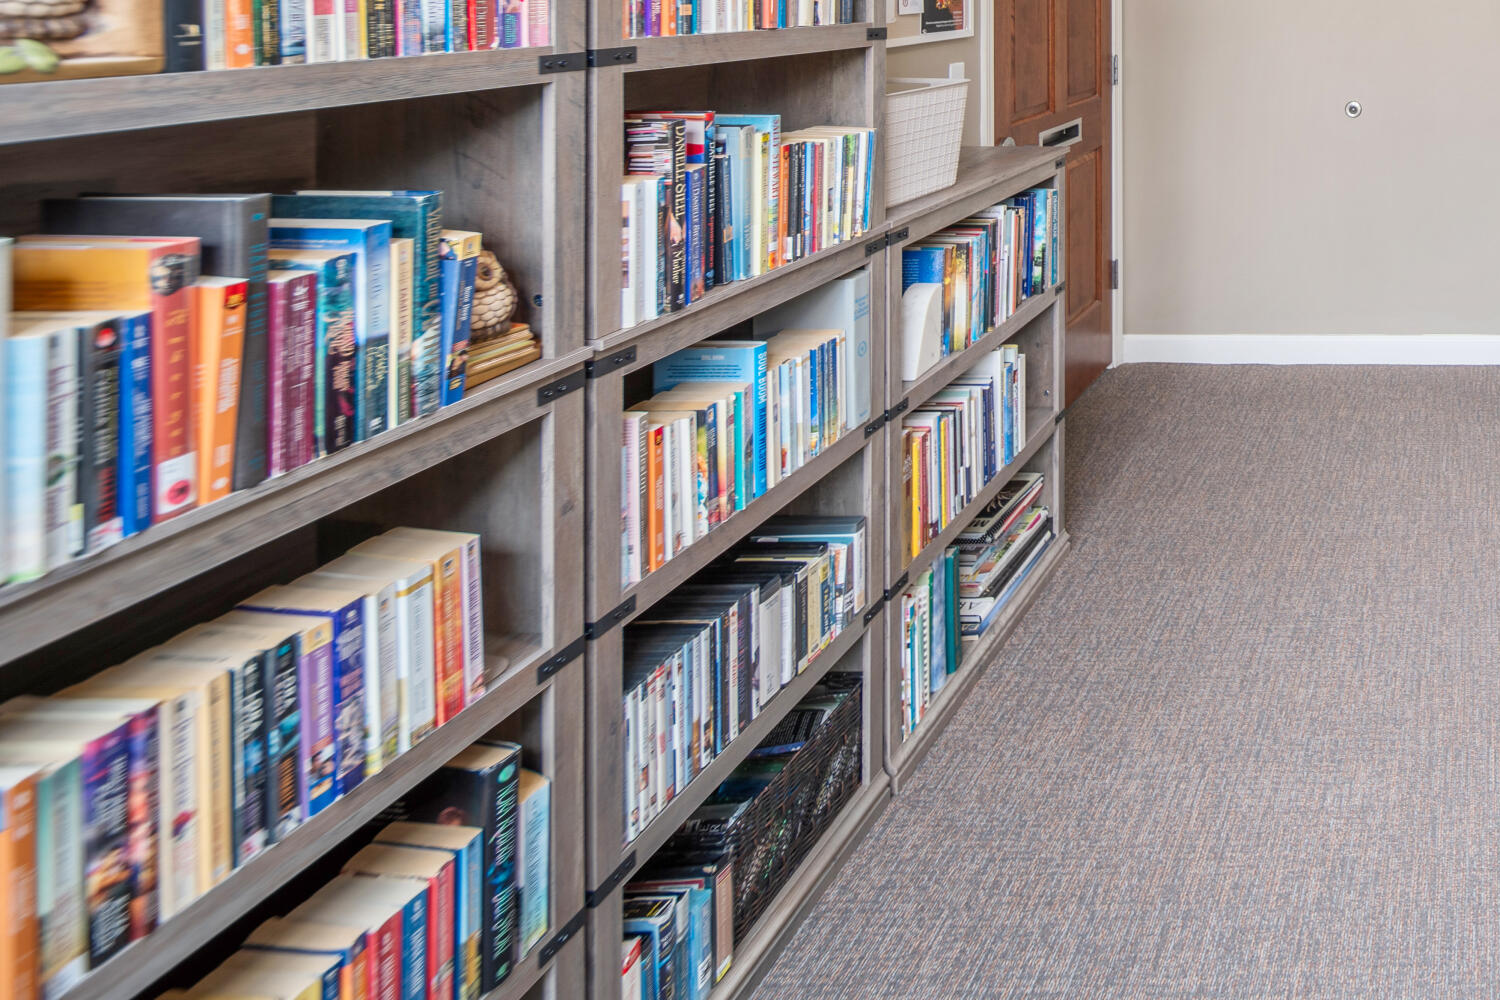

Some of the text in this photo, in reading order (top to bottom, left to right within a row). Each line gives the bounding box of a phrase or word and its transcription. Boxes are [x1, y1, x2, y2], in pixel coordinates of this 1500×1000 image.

[673, 126, 687, 221] DANIELLE STEEL
[708, 141, 716, 214] DANIELLE STEEL
[671, 250, 683, 287] Mother
